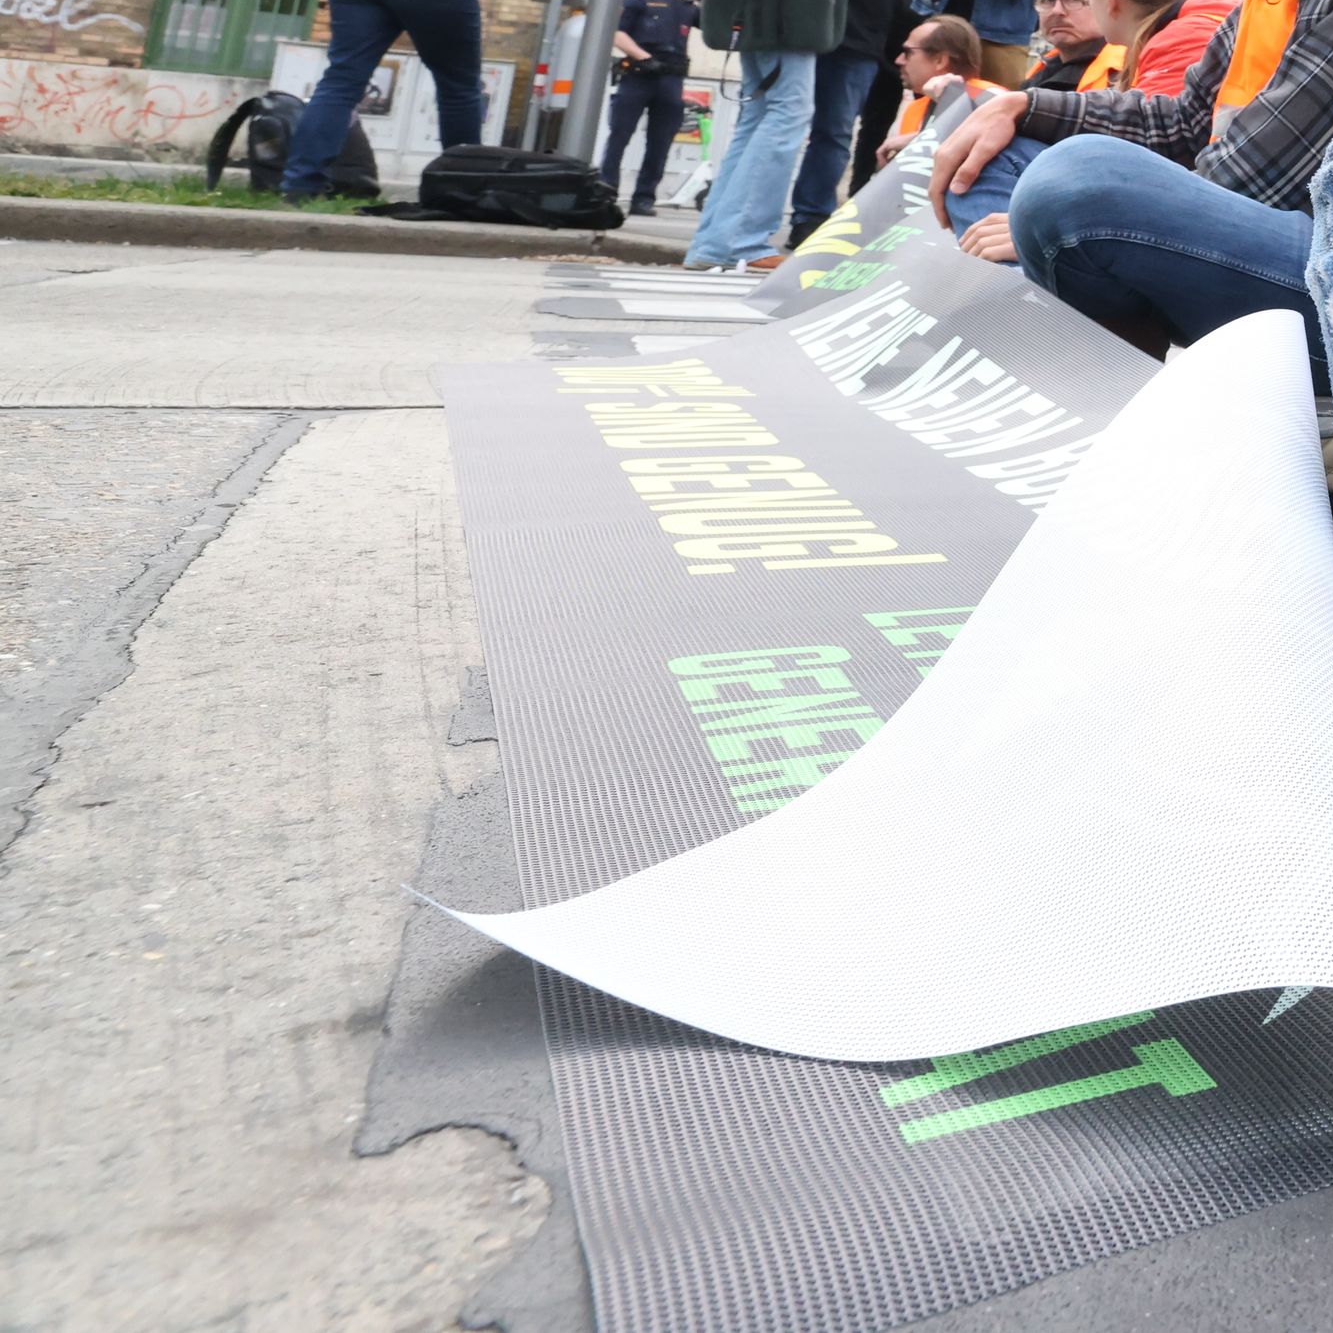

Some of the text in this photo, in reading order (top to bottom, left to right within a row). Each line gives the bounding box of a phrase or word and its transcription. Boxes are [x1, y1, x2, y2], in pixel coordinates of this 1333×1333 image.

[789, 280, 938, 397] KEINE
[857, 335, 1085, 458] NEUEN
[583, 401, 780, 450] SIND
[619, 455, 949, 576] GENUG!
